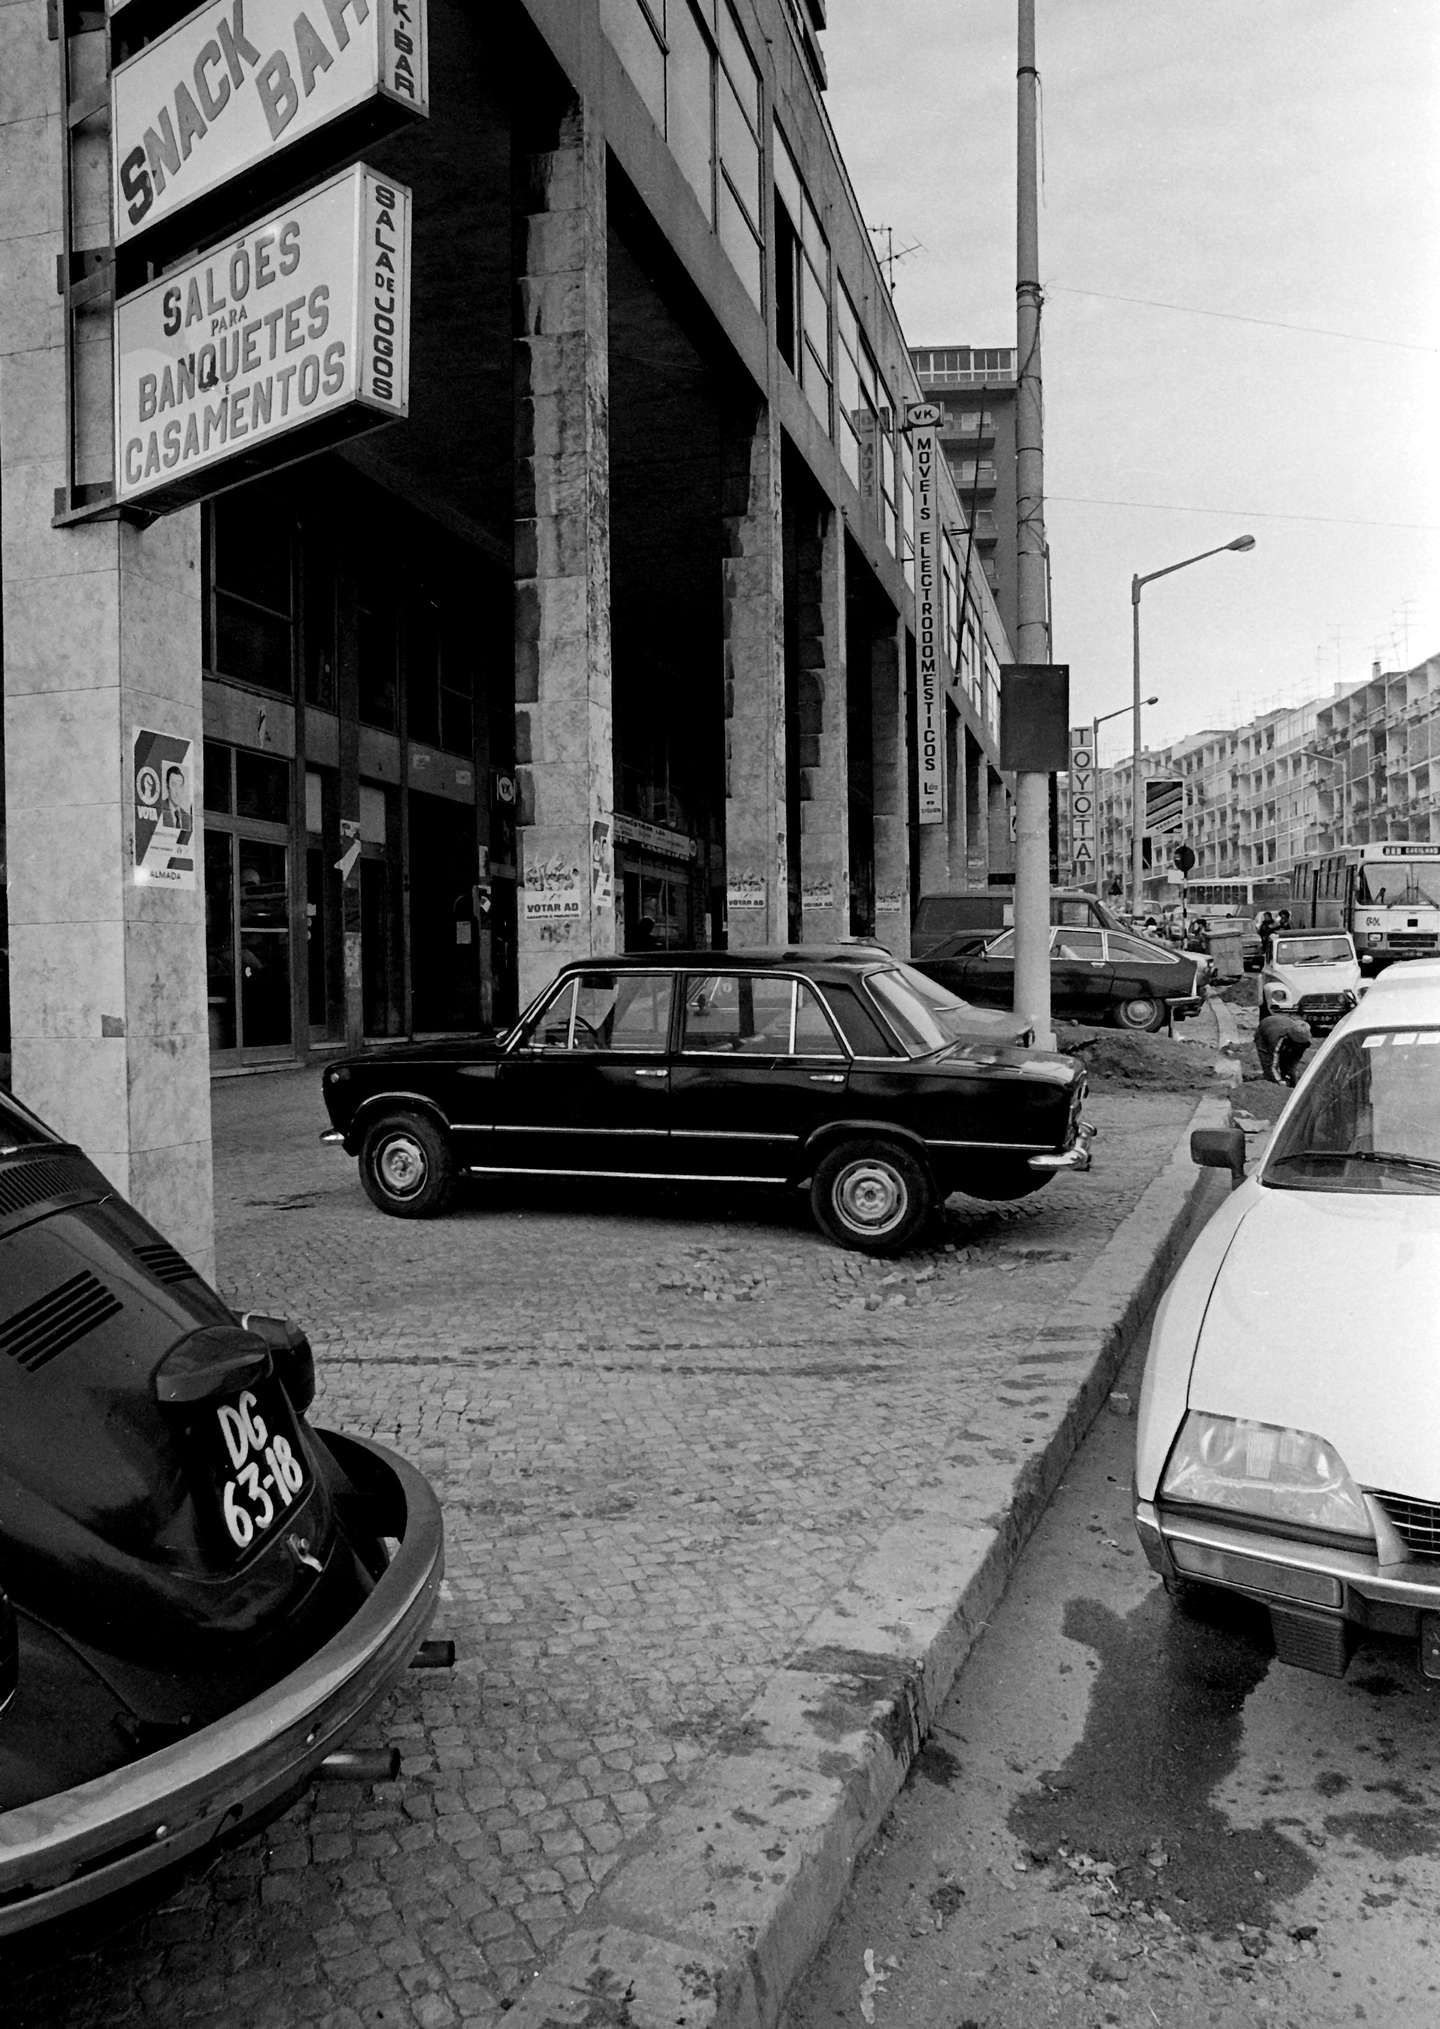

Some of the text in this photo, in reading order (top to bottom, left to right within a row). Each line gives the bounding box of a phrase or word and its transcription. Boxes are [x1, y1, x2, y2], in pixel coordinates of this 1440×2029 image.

[121, 0, 261, 225] SNACK
[139, 284, 330, 422] BANQUETES
[211, 304, 248, 336] PARA
[372, 184, 396, 401] SALA DE JOGOS
[125, 341, 346, 485] CASAMENTOS
[913, 409, 934, 420] VK
[1074, 728, 1092, 860] TOYOTA
[527, 902, 579, 913] VOTAR AD
[224, 1435, 303, 1548] 63-18
